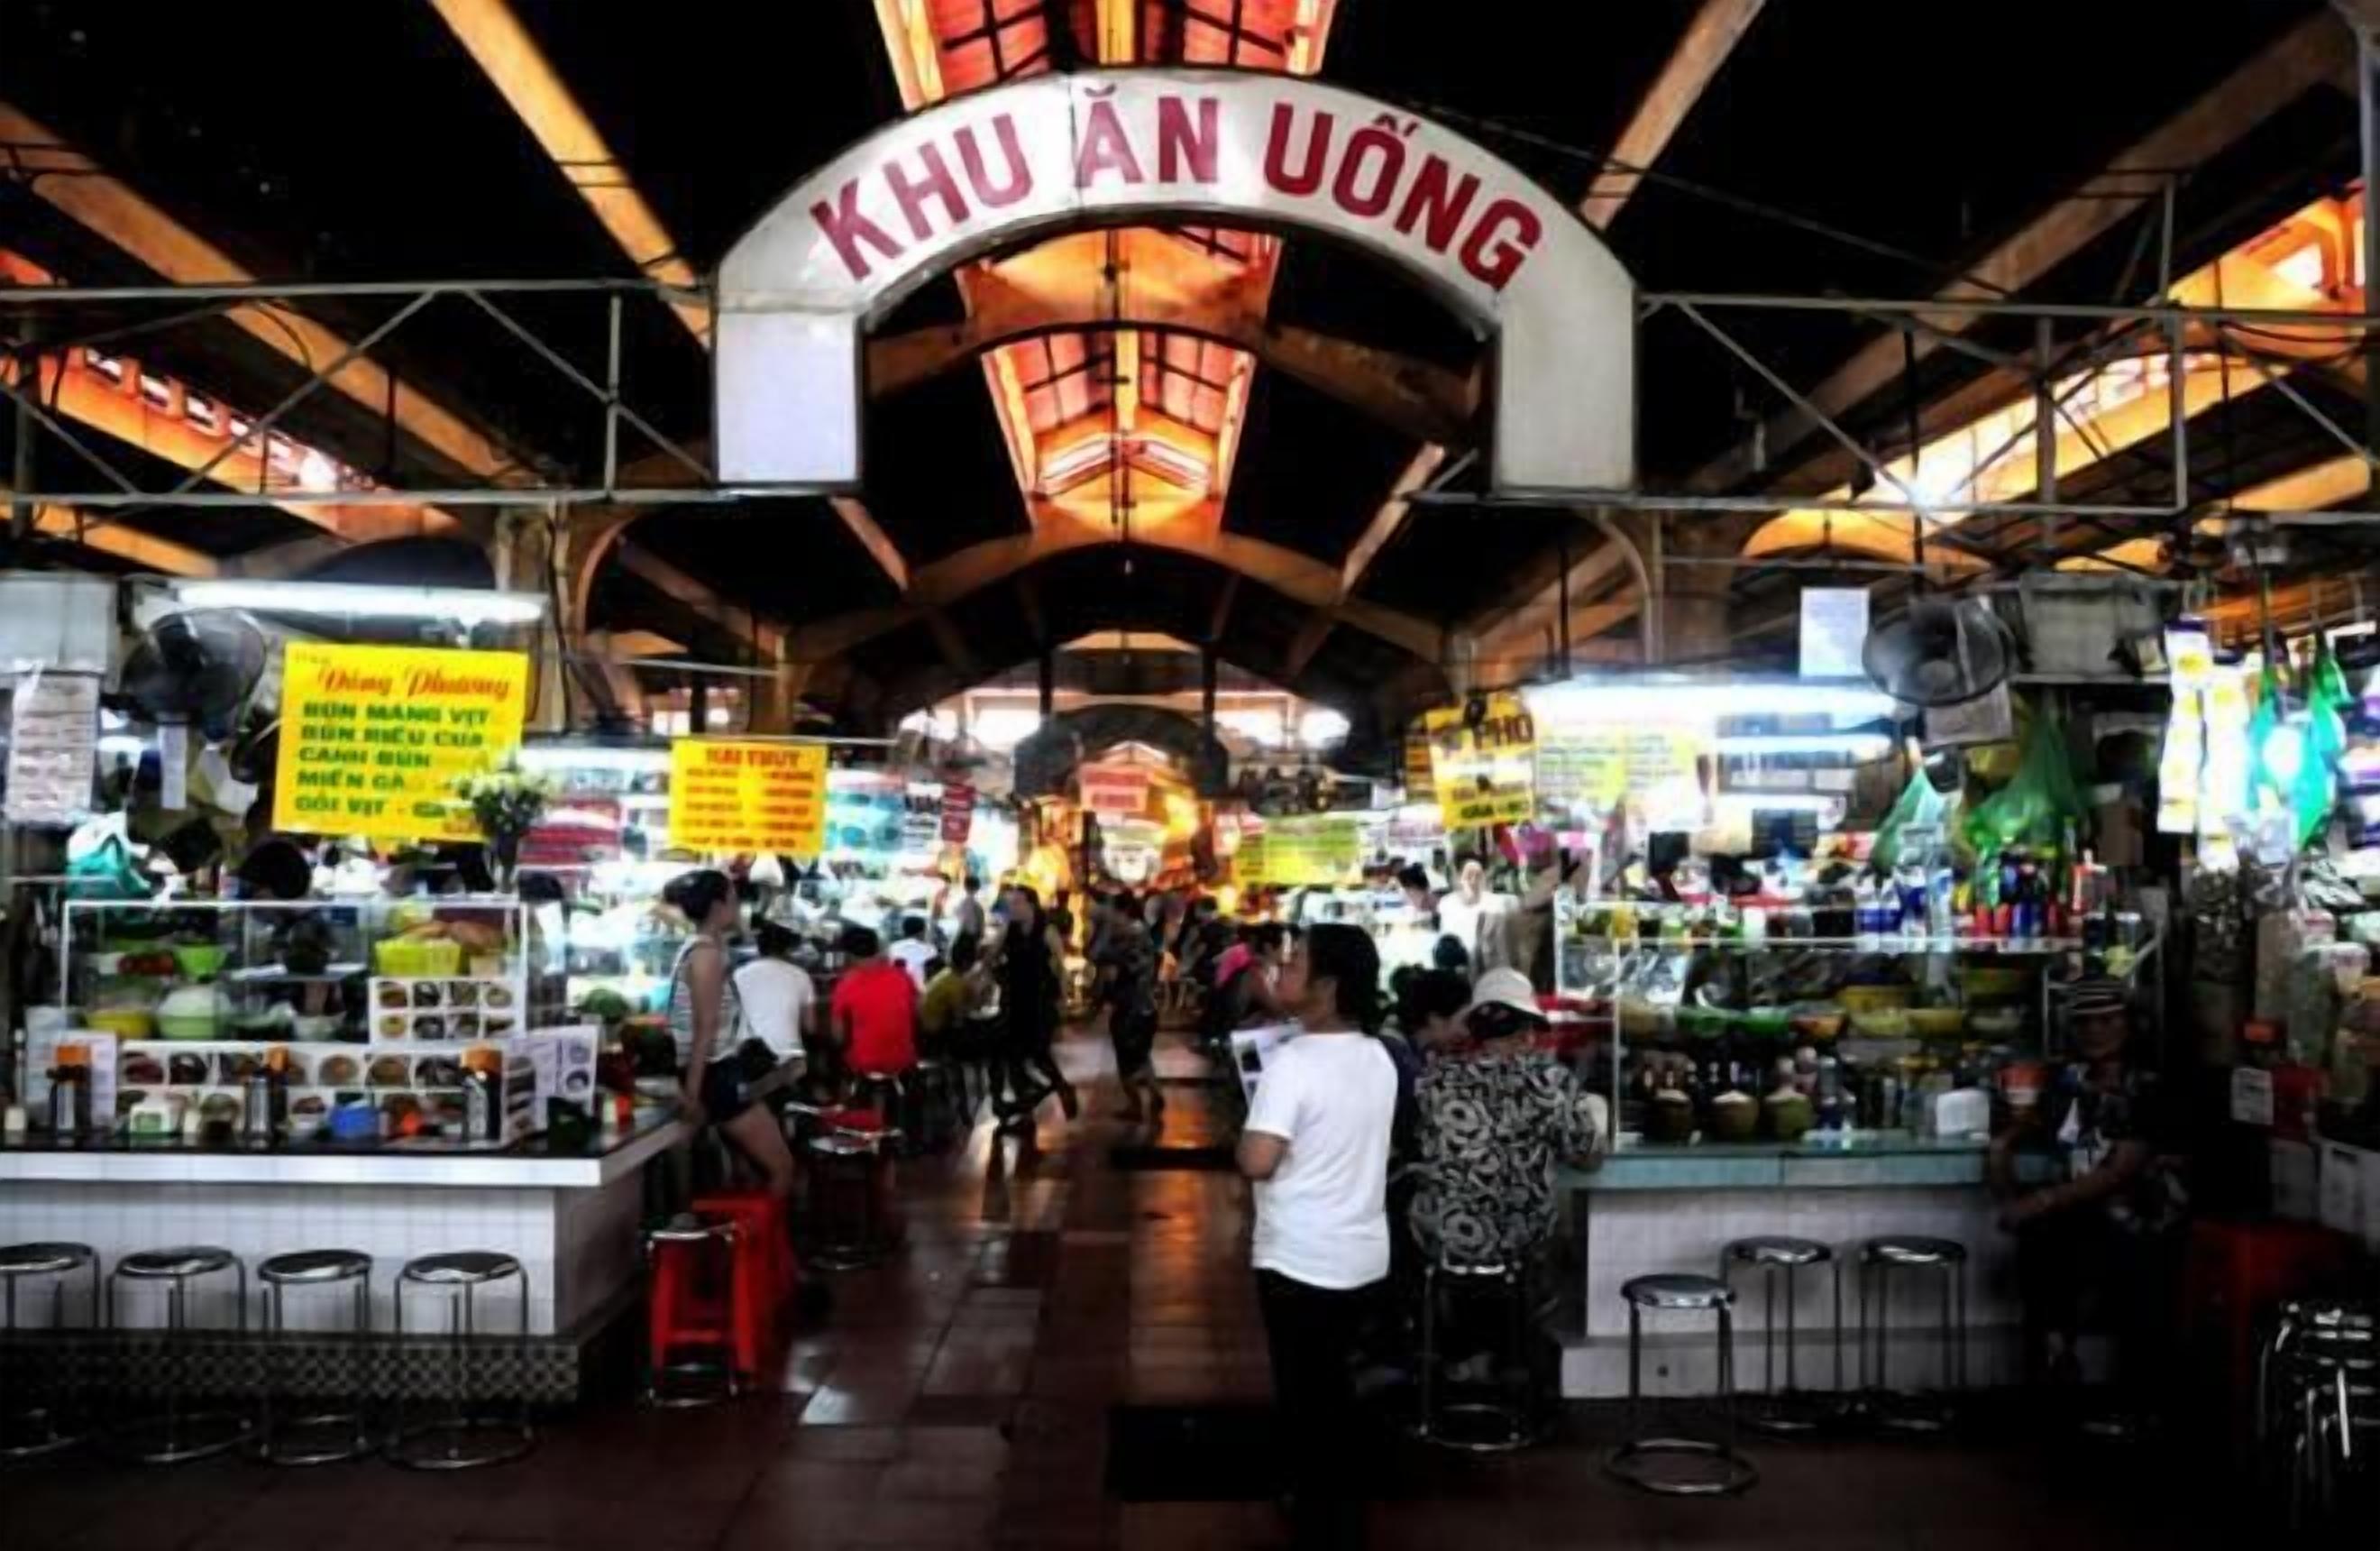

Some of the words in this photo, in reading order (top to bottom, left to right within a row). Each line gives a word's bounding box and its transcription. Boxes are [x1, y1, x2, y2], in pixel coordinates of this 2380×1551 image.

[810, 113, 1033, 281] KHU
[1075, 84, 1218, 184] ĂN
[1264, 101, 1542, 291] UỐNG
